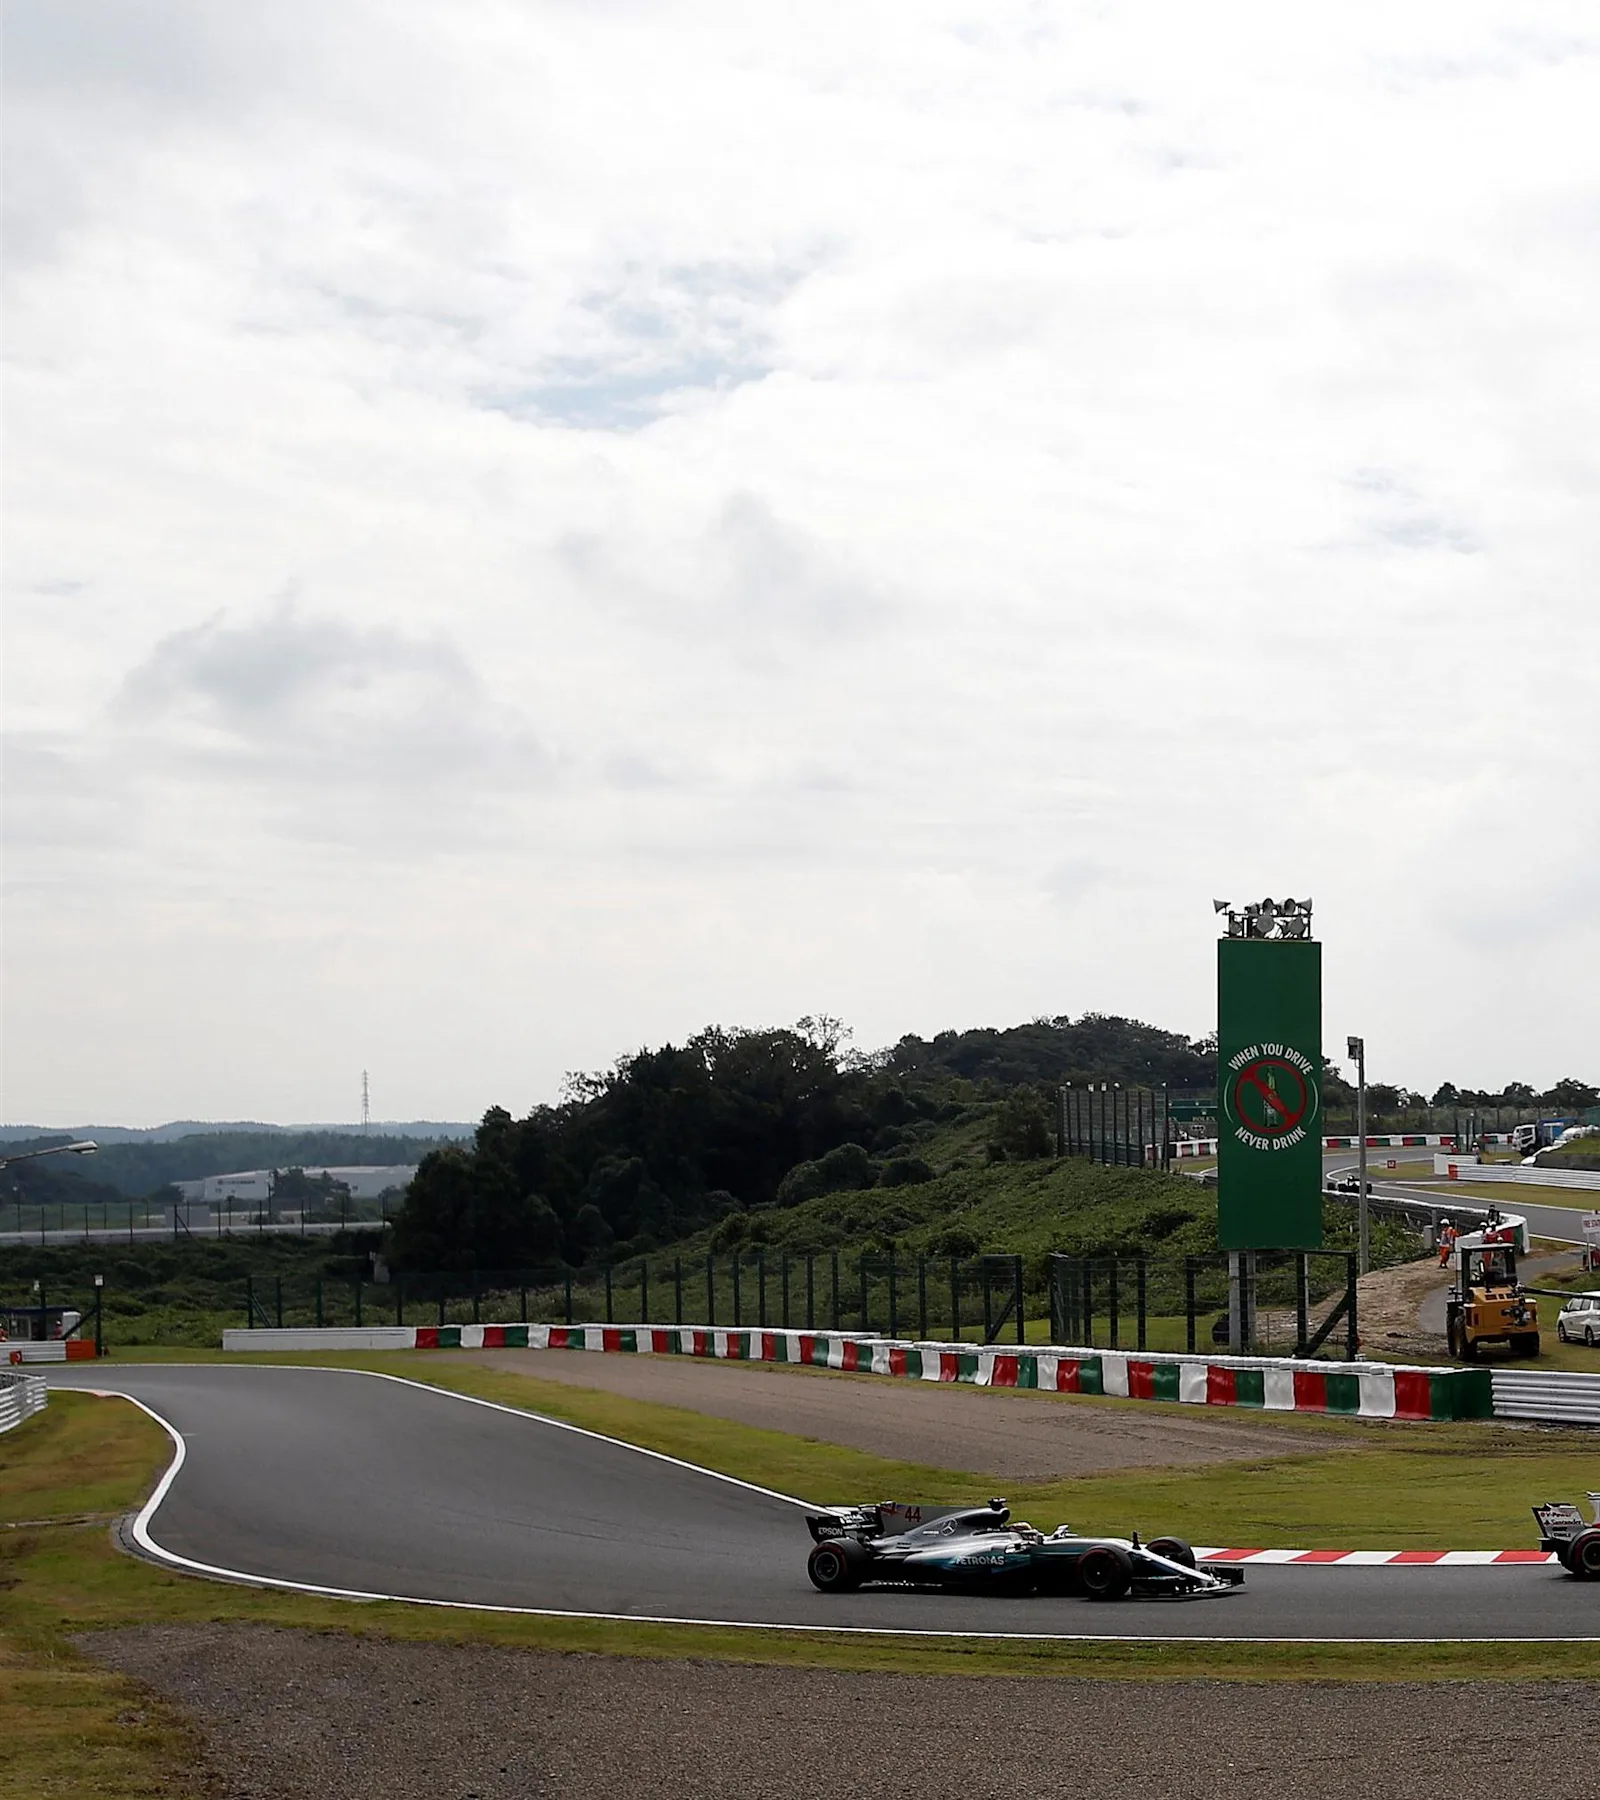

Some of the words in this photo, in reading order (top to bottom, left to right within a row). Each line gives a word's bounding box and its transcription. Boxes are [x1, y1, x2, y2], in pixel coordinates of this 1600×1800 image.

[1228, 1045, 1260, 1071] WHEN
[1261, 1043, 1283, 1056] YOU
[1284, 1047, 1314, 1075] DRIVE
[1234, 1126, 1269, 1150] NEVER
[1272, 1126, 1307, 1151] DRINK
[904, 1506, 921, 1522] 44
[818, 1527, 843, 1536] EPSON
